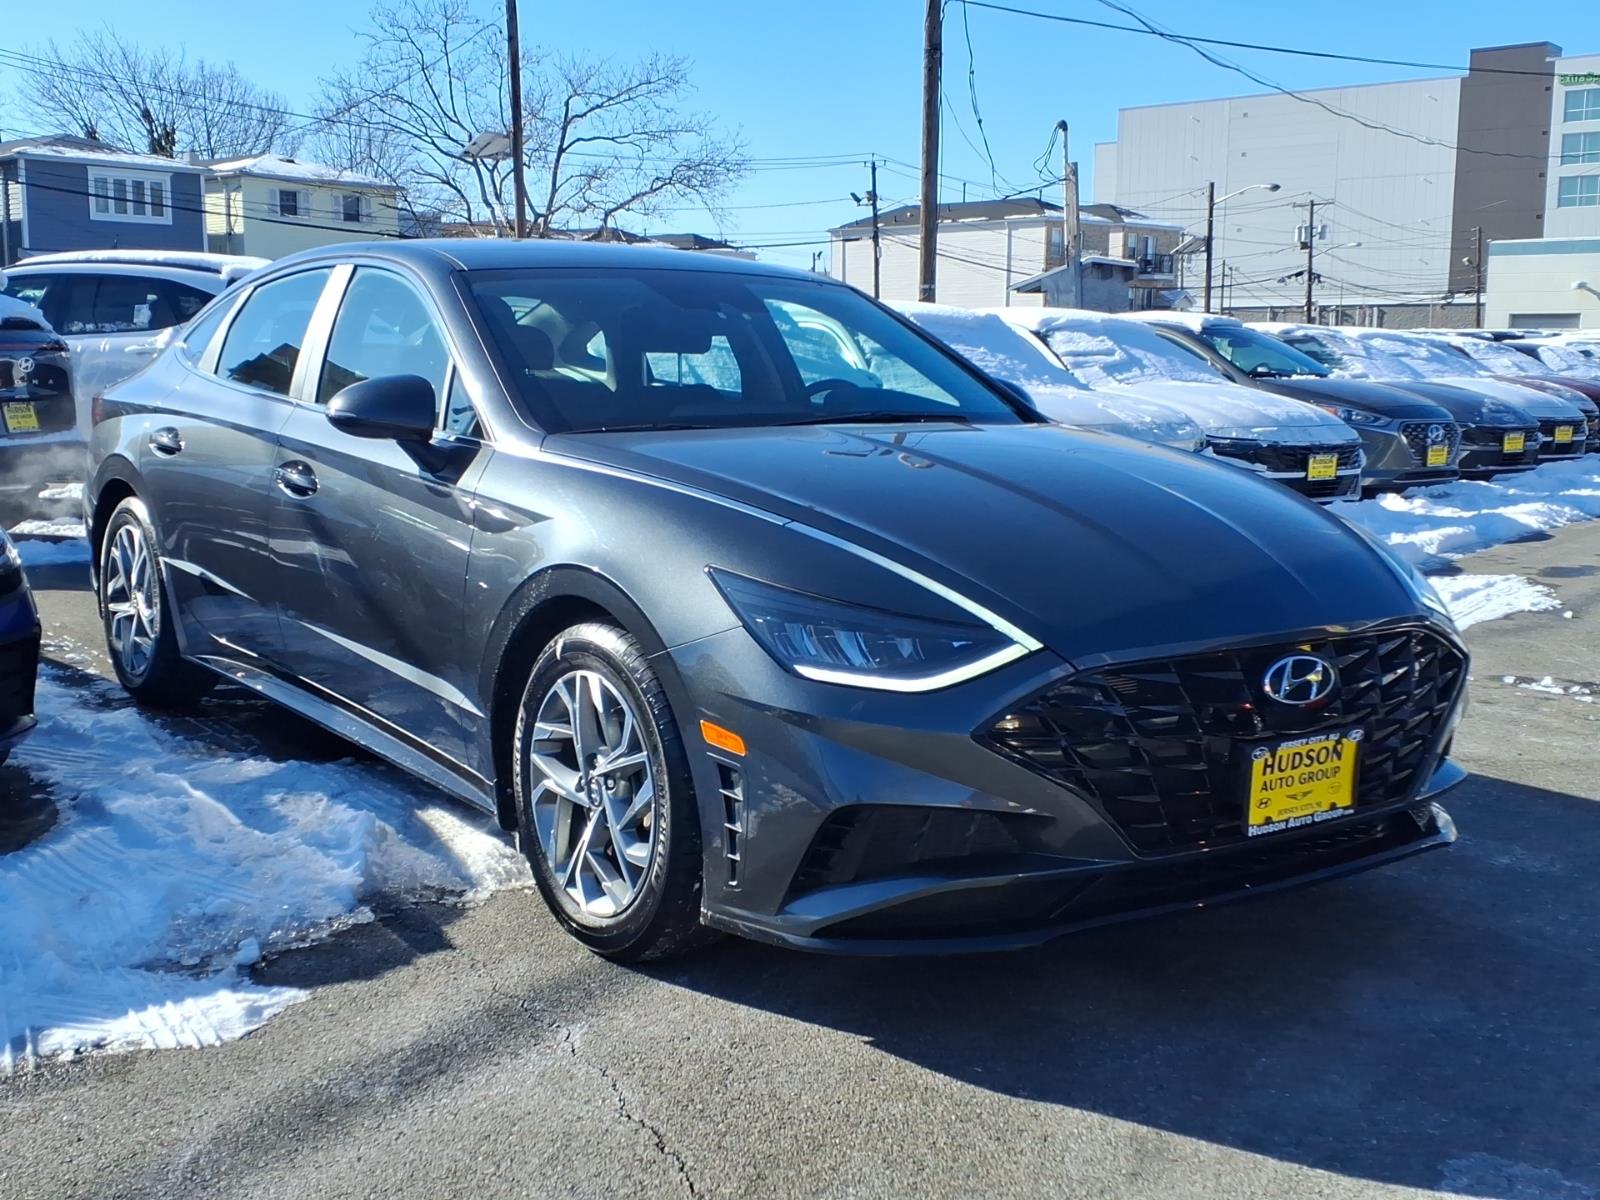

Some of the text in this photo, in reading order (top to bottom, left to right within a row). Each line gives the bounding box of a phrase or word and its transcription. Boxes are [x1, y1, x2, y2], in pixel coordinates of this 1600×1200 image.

[1262, 742, 1343, 776] HUDSON
[1260, 766, 1341, 793] AUTO GROUP
[655, 783, 668, 884] MICHELIN
[1247, 820, 1287, 837] HUDSON
[1287, 815, 1313, 829] AUTO
